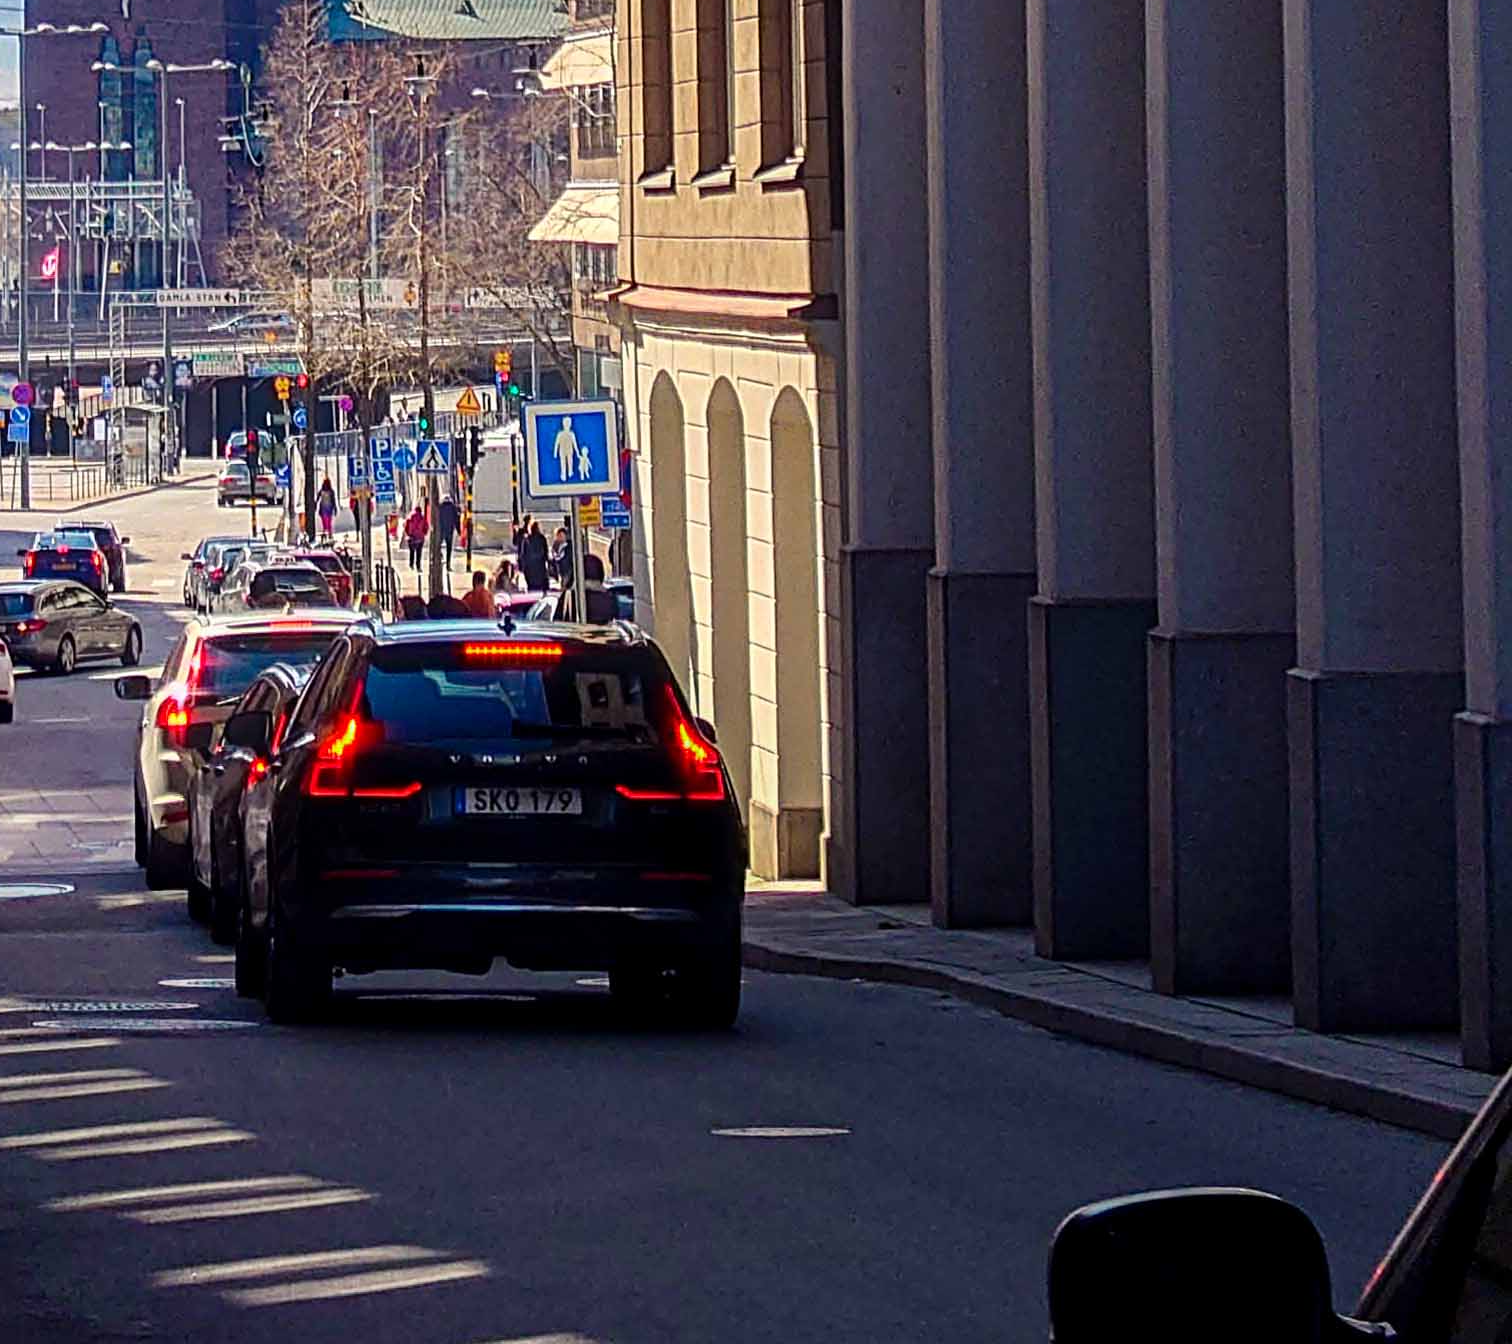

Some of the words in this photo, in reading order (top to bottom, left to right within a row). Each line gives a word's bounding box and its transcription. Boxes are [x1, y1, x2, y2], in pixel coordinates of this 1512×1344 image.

[376, 439, 388, 458] P
[474, 790, 520, 811] SKO
[531, 790, 573, 811] 179
